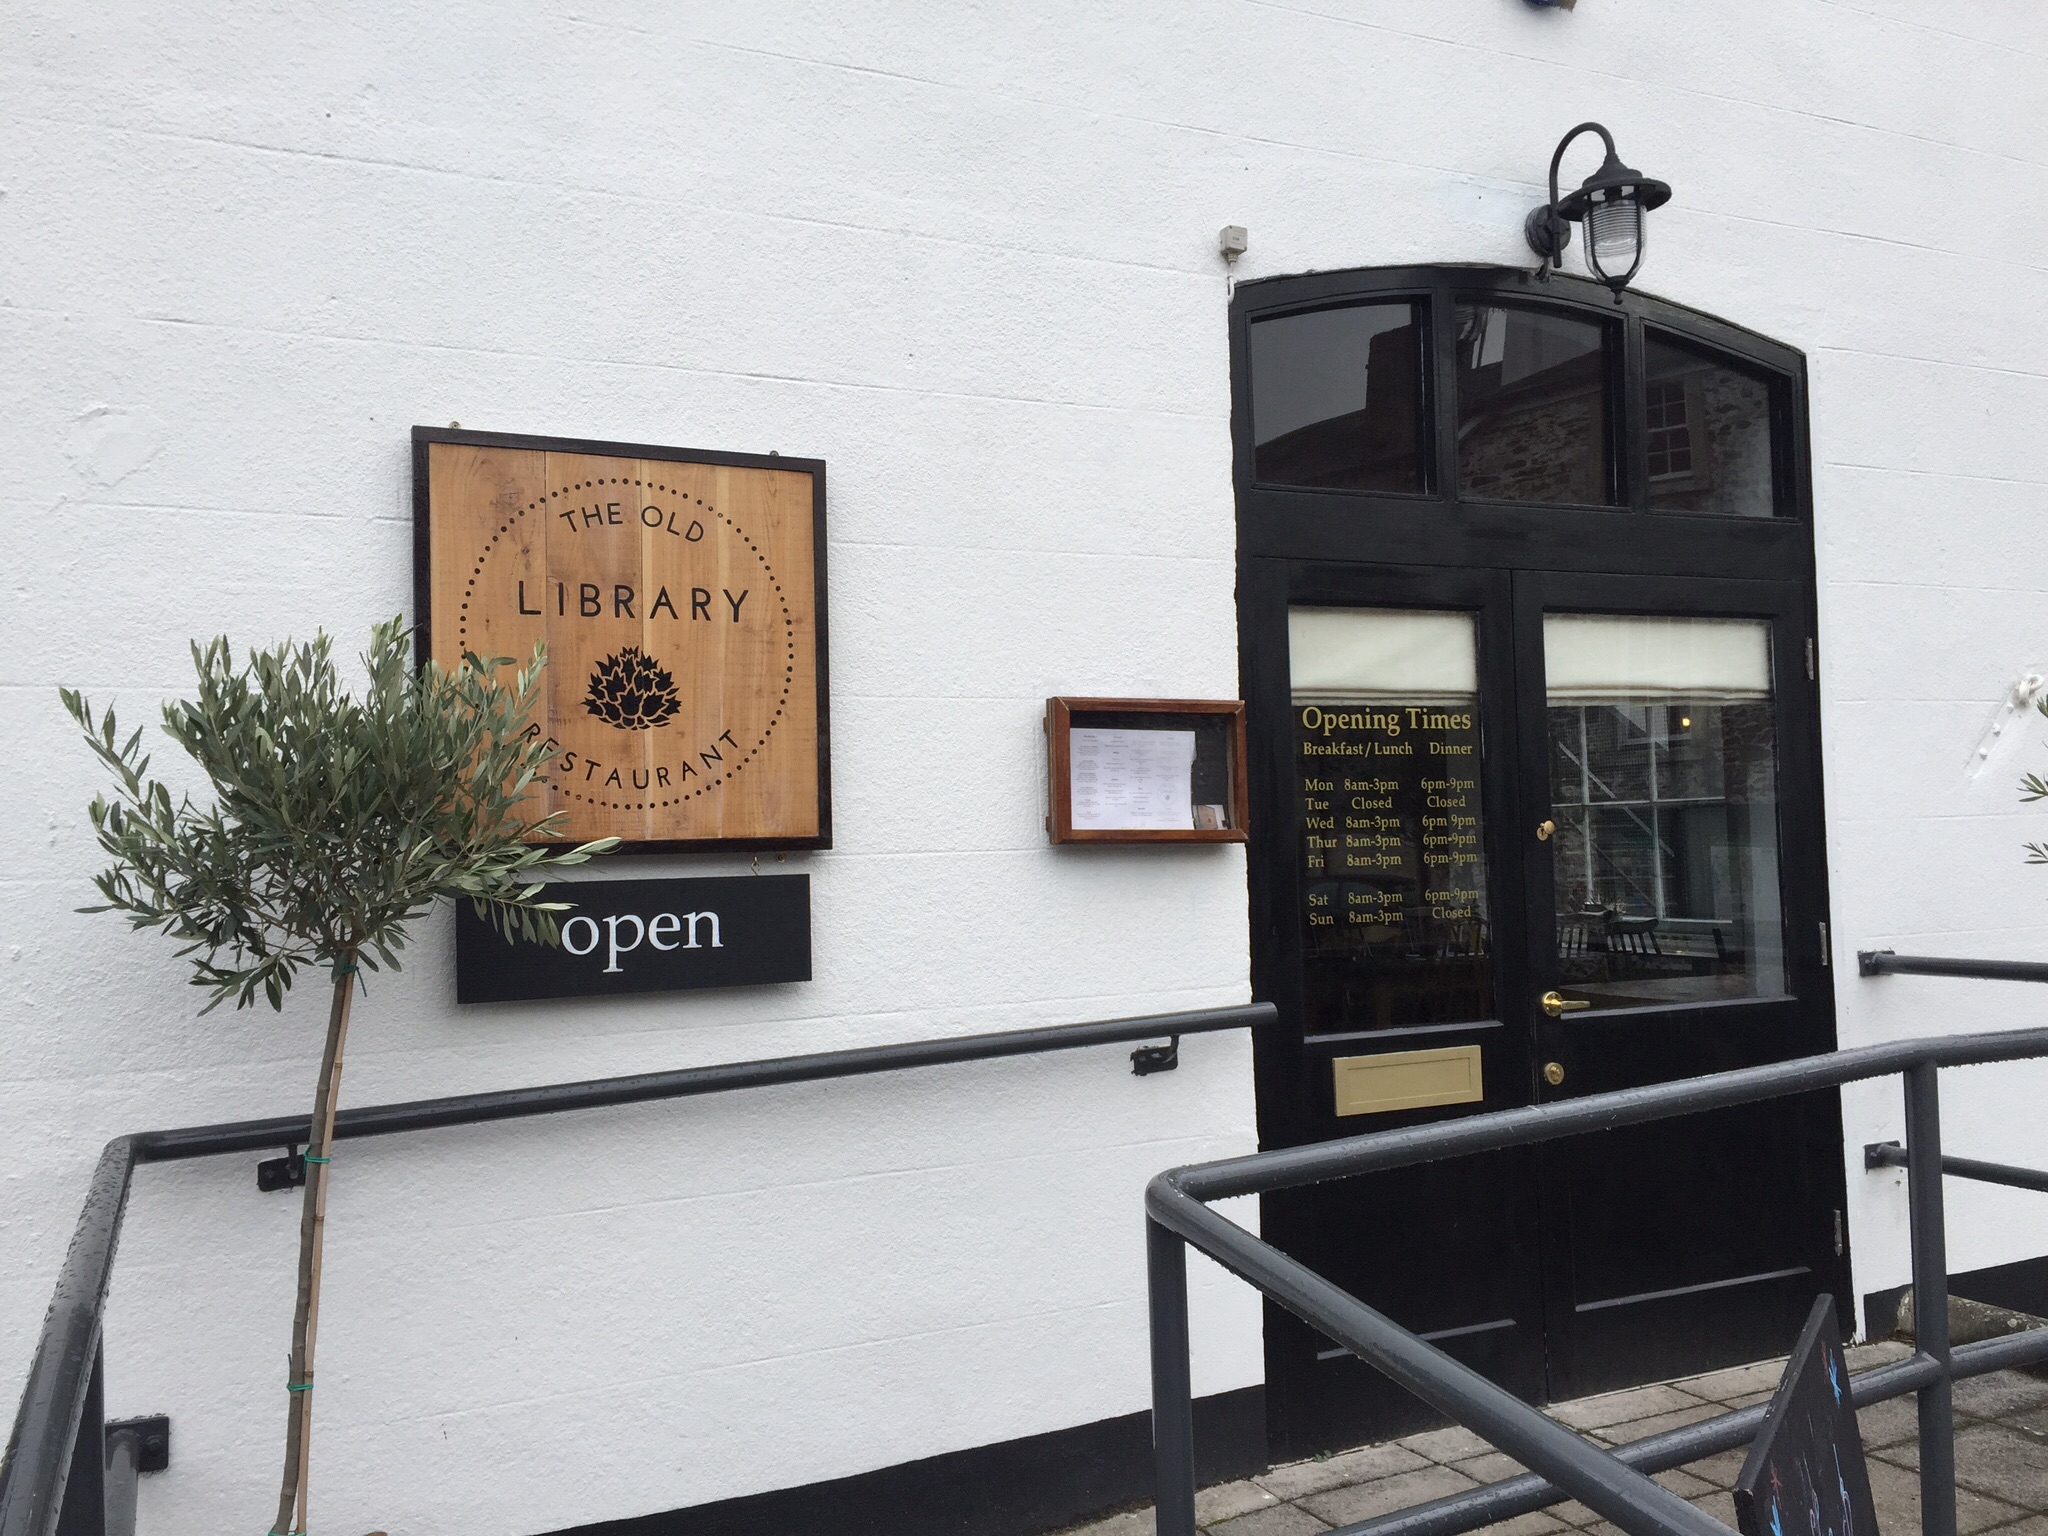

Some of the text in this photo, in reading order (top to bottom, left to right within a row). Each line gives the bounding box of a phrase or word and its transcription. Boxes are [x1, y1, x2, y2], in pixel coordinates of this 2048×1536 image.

[559, 502, 705, 543] THE OLD
[518, 580, 749, 623] LIBRARY
[1302, 706, 1472, 737] Opening Times
[520, 722, 739, 791] RESTAURANT
[1374, 741, 1413, 755] Lunch
[1429, 742, 1472, 755] Dinner
[1305, 777, 1475, 793] Mon 8am-3pm 6pm-9pm
[1305, 795, 1466, 810] Tue Closed Closed
[1306, 815, 1335, 829] Wed
[1345, 815, 1400, 831] 8am-3pm
[1307, 832, 1477, 850] Thur 8am-3pm 6pm-9pm
[1307, 850, 1478, 869] Fri 8am-3pm 6pm-9pm
[1308, 887, 1479, 906] Sat 8am-3pm 6pm-9pm
[1309, 905, 1472, 926] Sun 8am-3pm Closed
[561, 911, 724, 973] open
